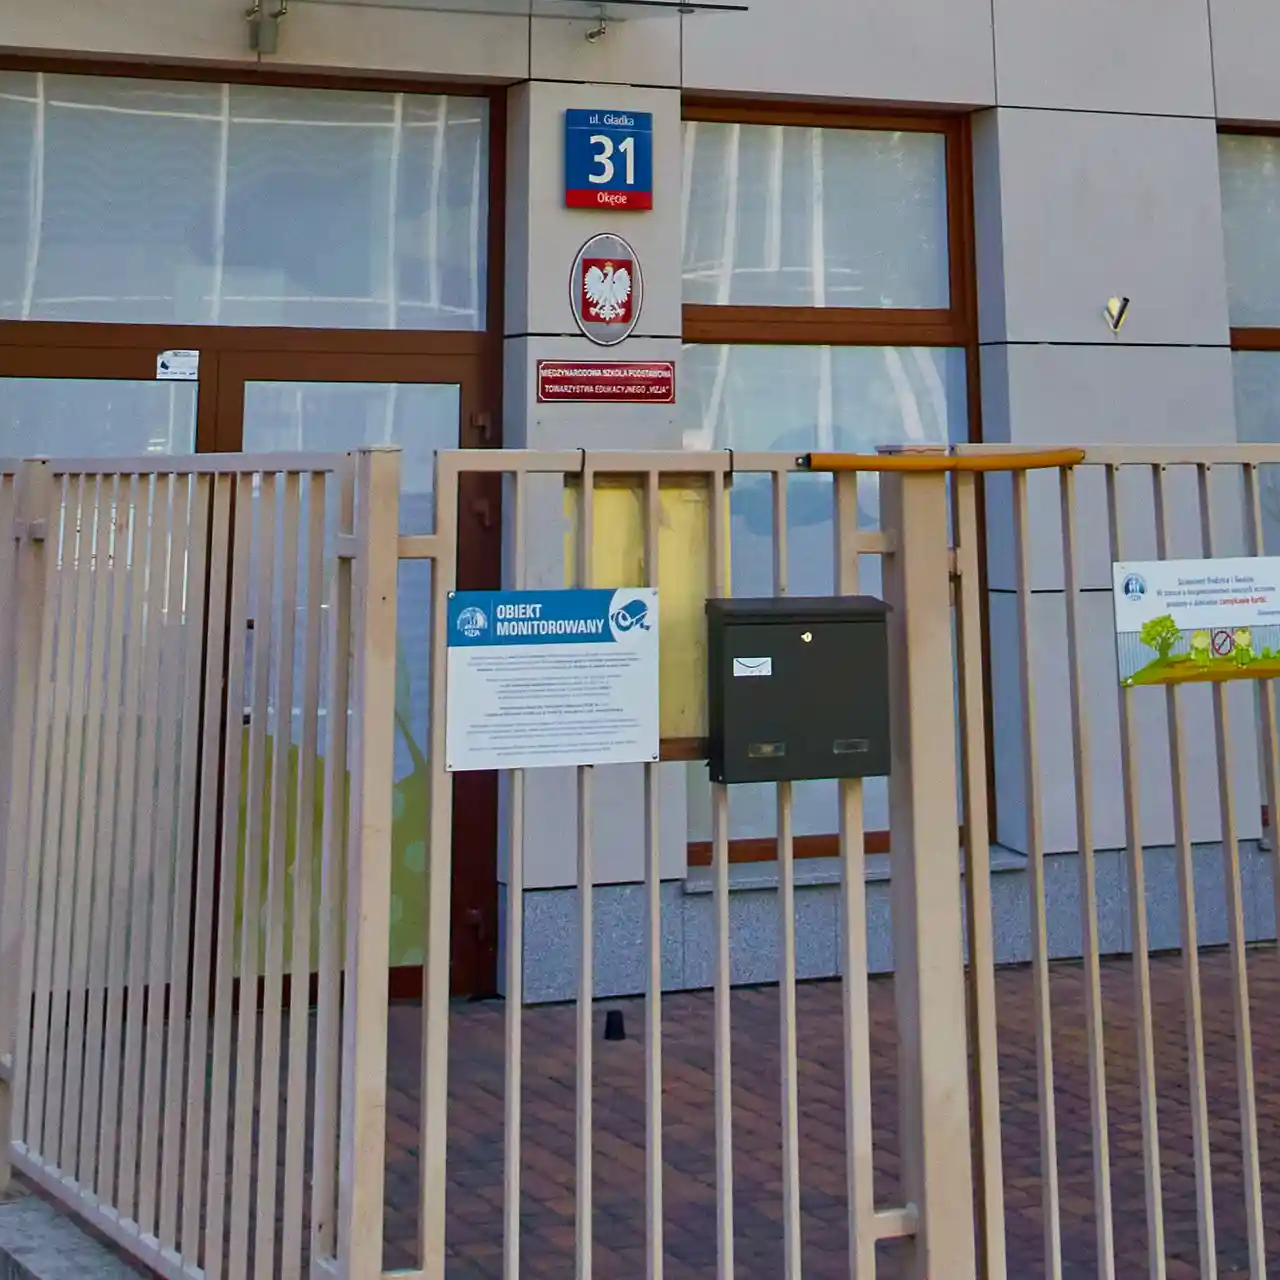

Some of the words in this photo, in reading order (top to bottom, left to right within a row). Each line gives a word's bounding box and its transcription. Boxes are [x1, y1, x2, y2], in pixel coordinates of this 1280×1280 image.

[589, 114, 601, 125] ul.
[588, 134, 634, 185] 31
[597, 191, 628, 206] Okęcie
[496, 603, 543, 619] OBIEKT
[496, 619, 605, 637] MONITOROWANY
